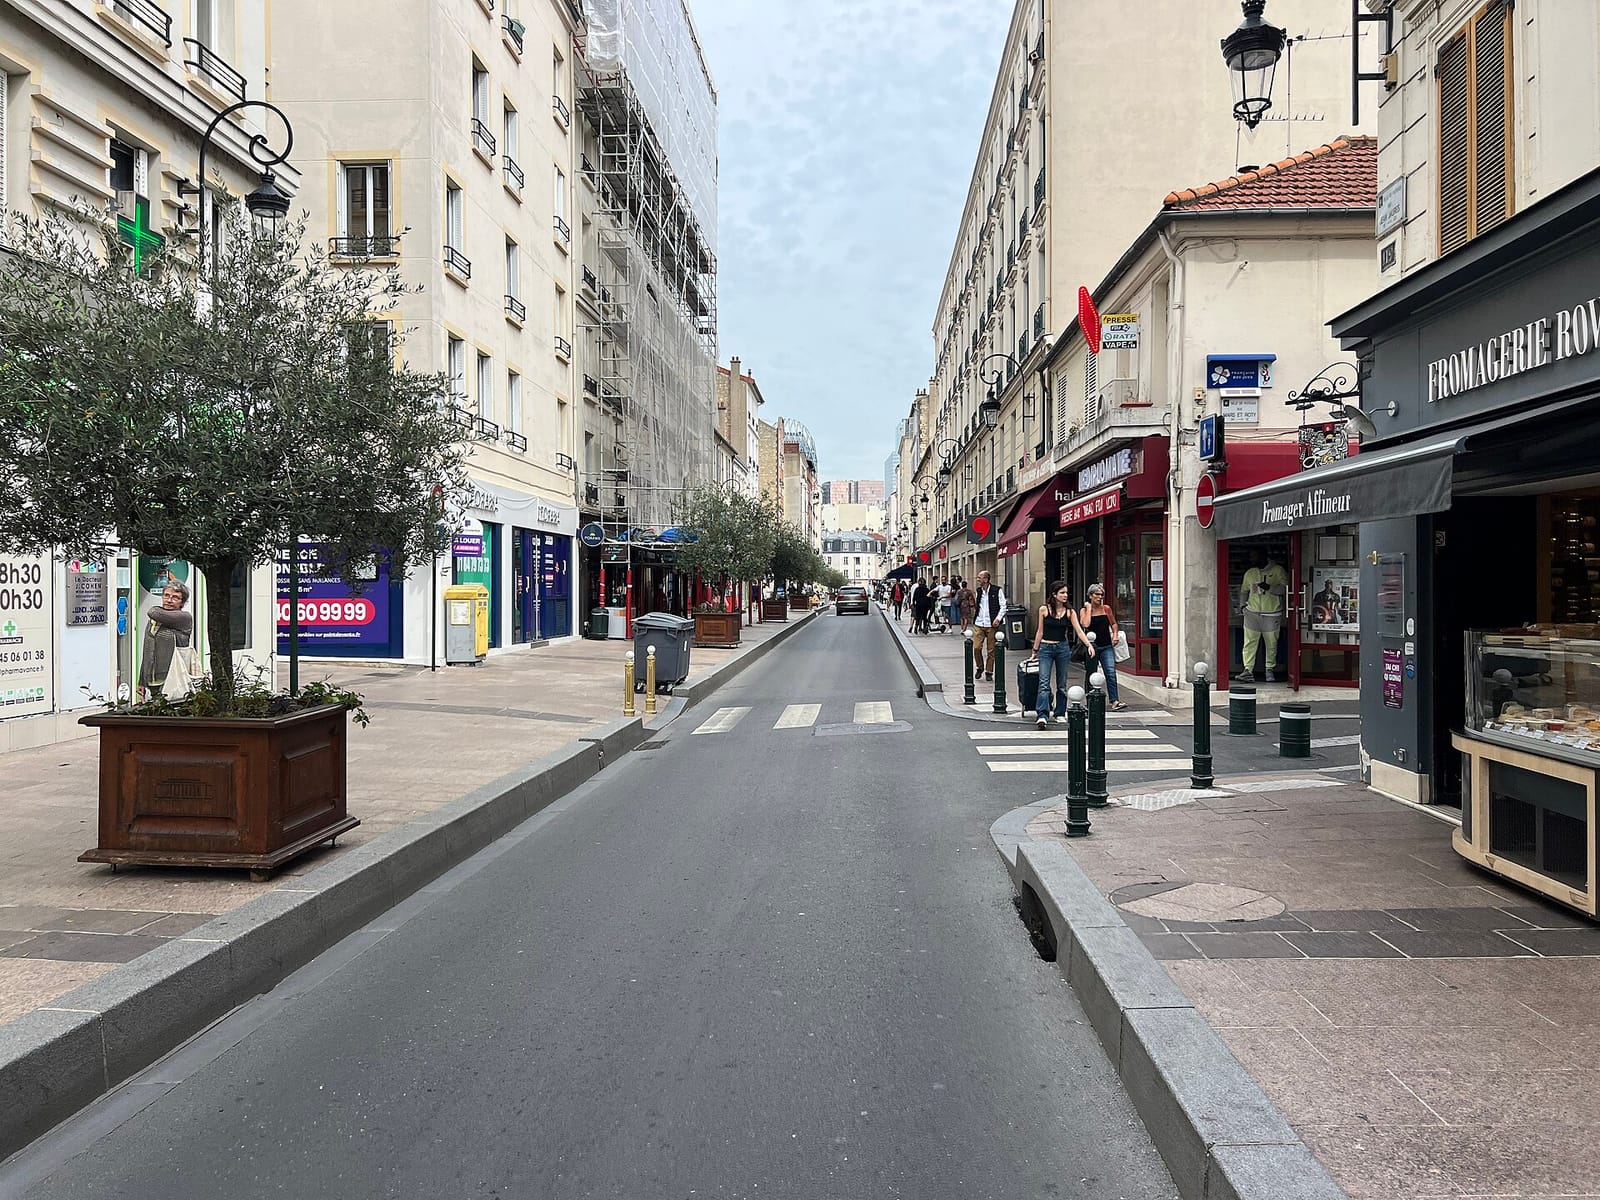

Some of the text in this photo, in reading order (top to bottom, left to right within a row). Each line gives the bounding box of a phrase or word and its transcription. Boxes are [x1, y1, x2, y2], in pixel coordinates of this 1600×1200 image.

[1106, 316, 1137, 324] PRESSE
[1427, 317, 1547, 403] FROMAGERIE
[1262, 489, 1351, 526] Fromager Affineur
[0, 563, 41, 584] 8h30
[0, 589, 43, 610] 0h30
[298, 602, 318, 621] 60
[320, 602, 341, 621] 99
[344, 602, 366, 621] 99
[11, 652, 20, 662] 06
[23, 651, 32, 661] 01
[35, 650, 45, 660] 38
[0, 666, 44, 676] pharmavance.fr
